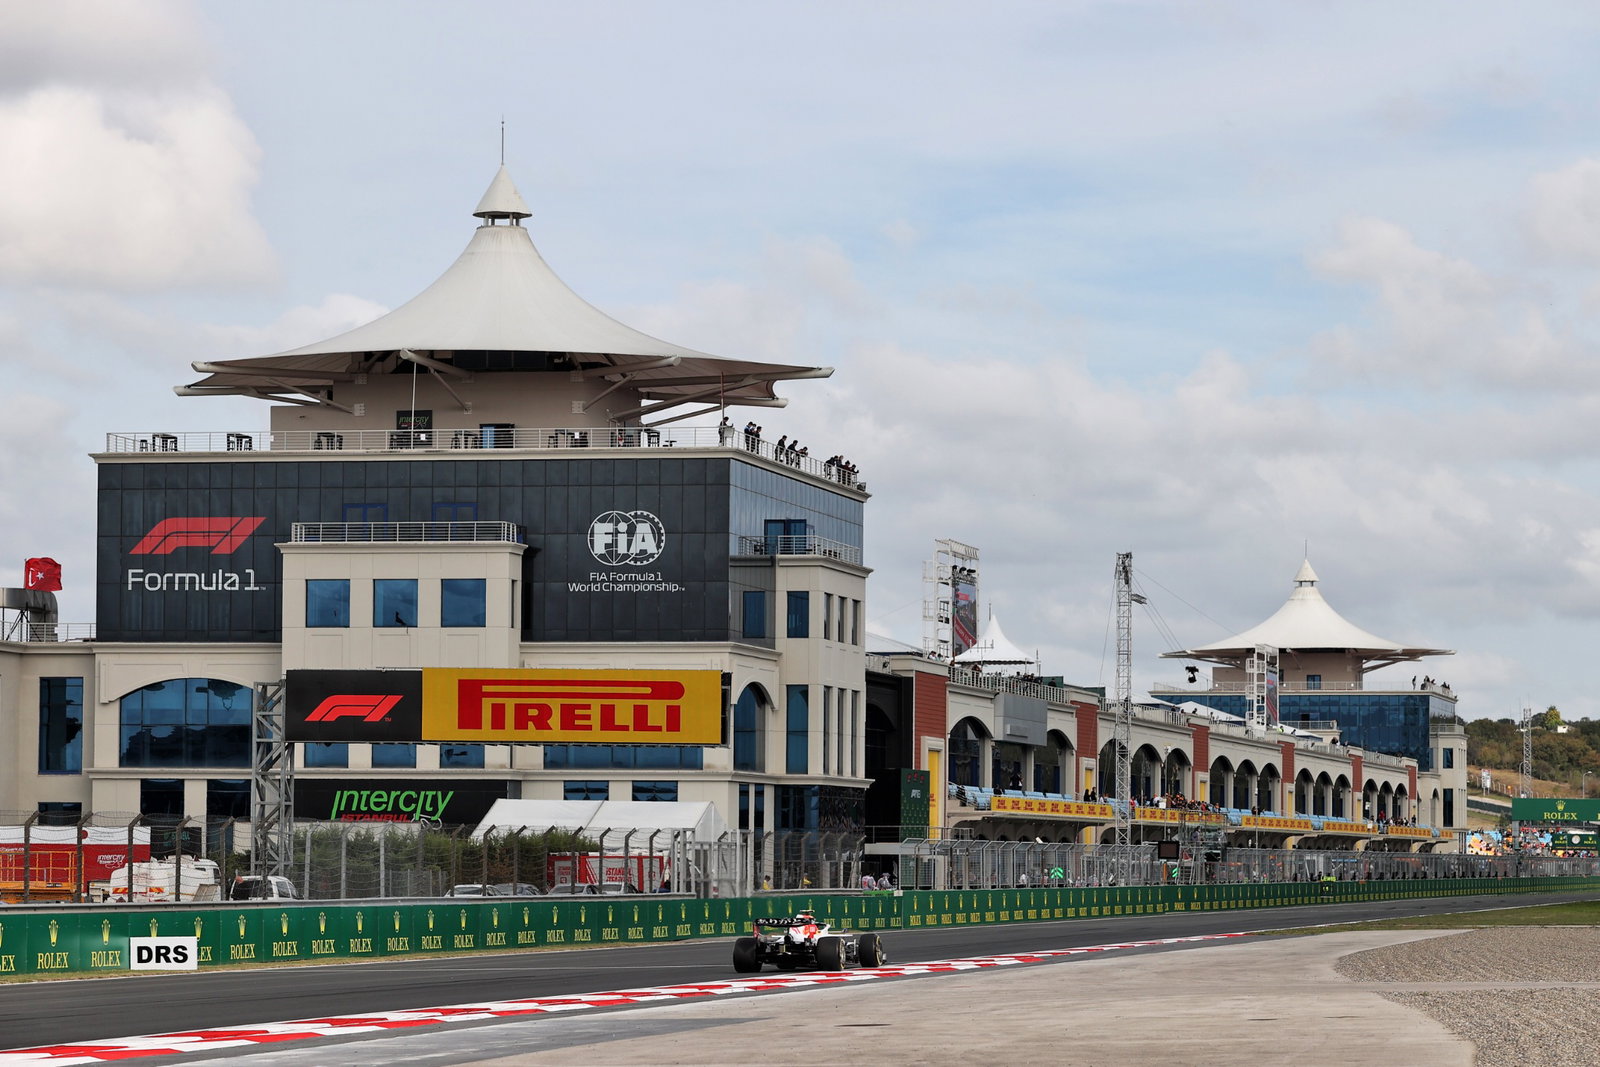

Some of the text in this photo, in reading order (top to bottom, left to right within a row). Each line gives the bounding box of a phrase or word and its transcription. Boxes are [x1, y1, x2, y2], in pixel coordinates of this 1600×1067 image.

[128, 569, 240, 591] Formula
[245, 569, 260, 591] 1
[590, 572, 663, 582] FIA Formula 1
[568, 582, 679, 593] World Championship
[457, 679, 686, 733] PIRELLI
[1543, 812, 1578, 820] ROLEX
[454, 934, 474, 948] ROLEX
[486, 932, 506, 946] ROLEX
[518, 931, 536, 944] ROLEX
[547, 929, 565, 942] ROLEX
[574, 929, 592, 941] ROLEX
[602, 928, 619, 941] ROLEX
[273, 941, 298, 957] ROLEX
[312, 940, 335, 954] ROLEX
[350, 938, 372, 953] ROLEX
[387, 937, 409, 951] ROLEX
[421, 935, 442, 949] ROLEX
[137, 945, 189, 964] DRS
[230, 944, 256, 959] ROLEX
[37, 952, 69, 969] ROLEX
[91, 950, 121, 968] ROLEX
